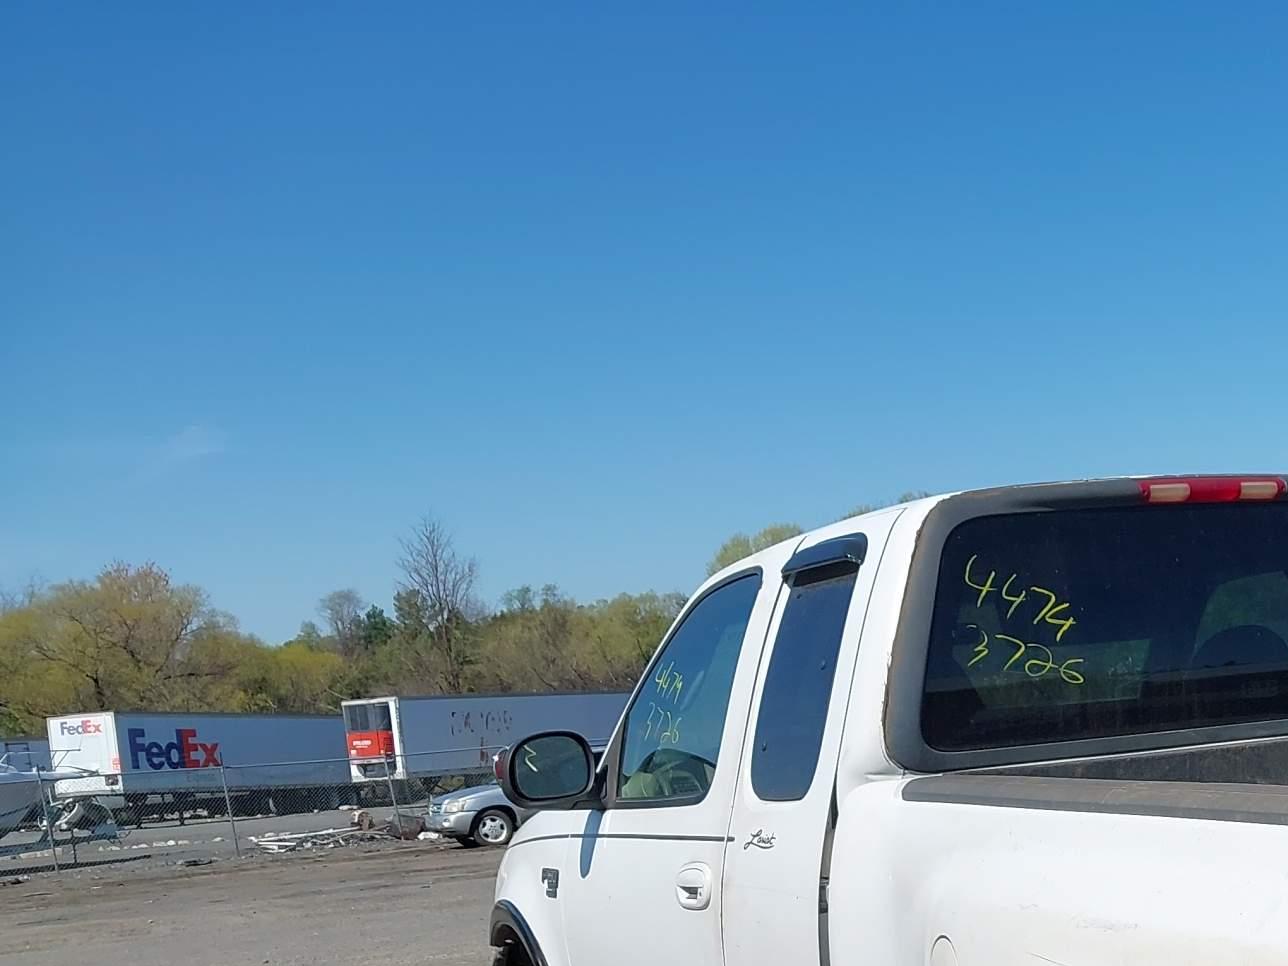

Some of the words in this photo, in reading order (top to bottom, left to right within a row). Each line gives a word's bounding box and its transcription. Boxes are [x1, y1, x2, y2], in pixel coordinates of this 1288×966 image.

[966, 624, 1085, 684] 3726
[60, 720, 102, 736] FedEx
[128, 728, 222, 770] FedEx
